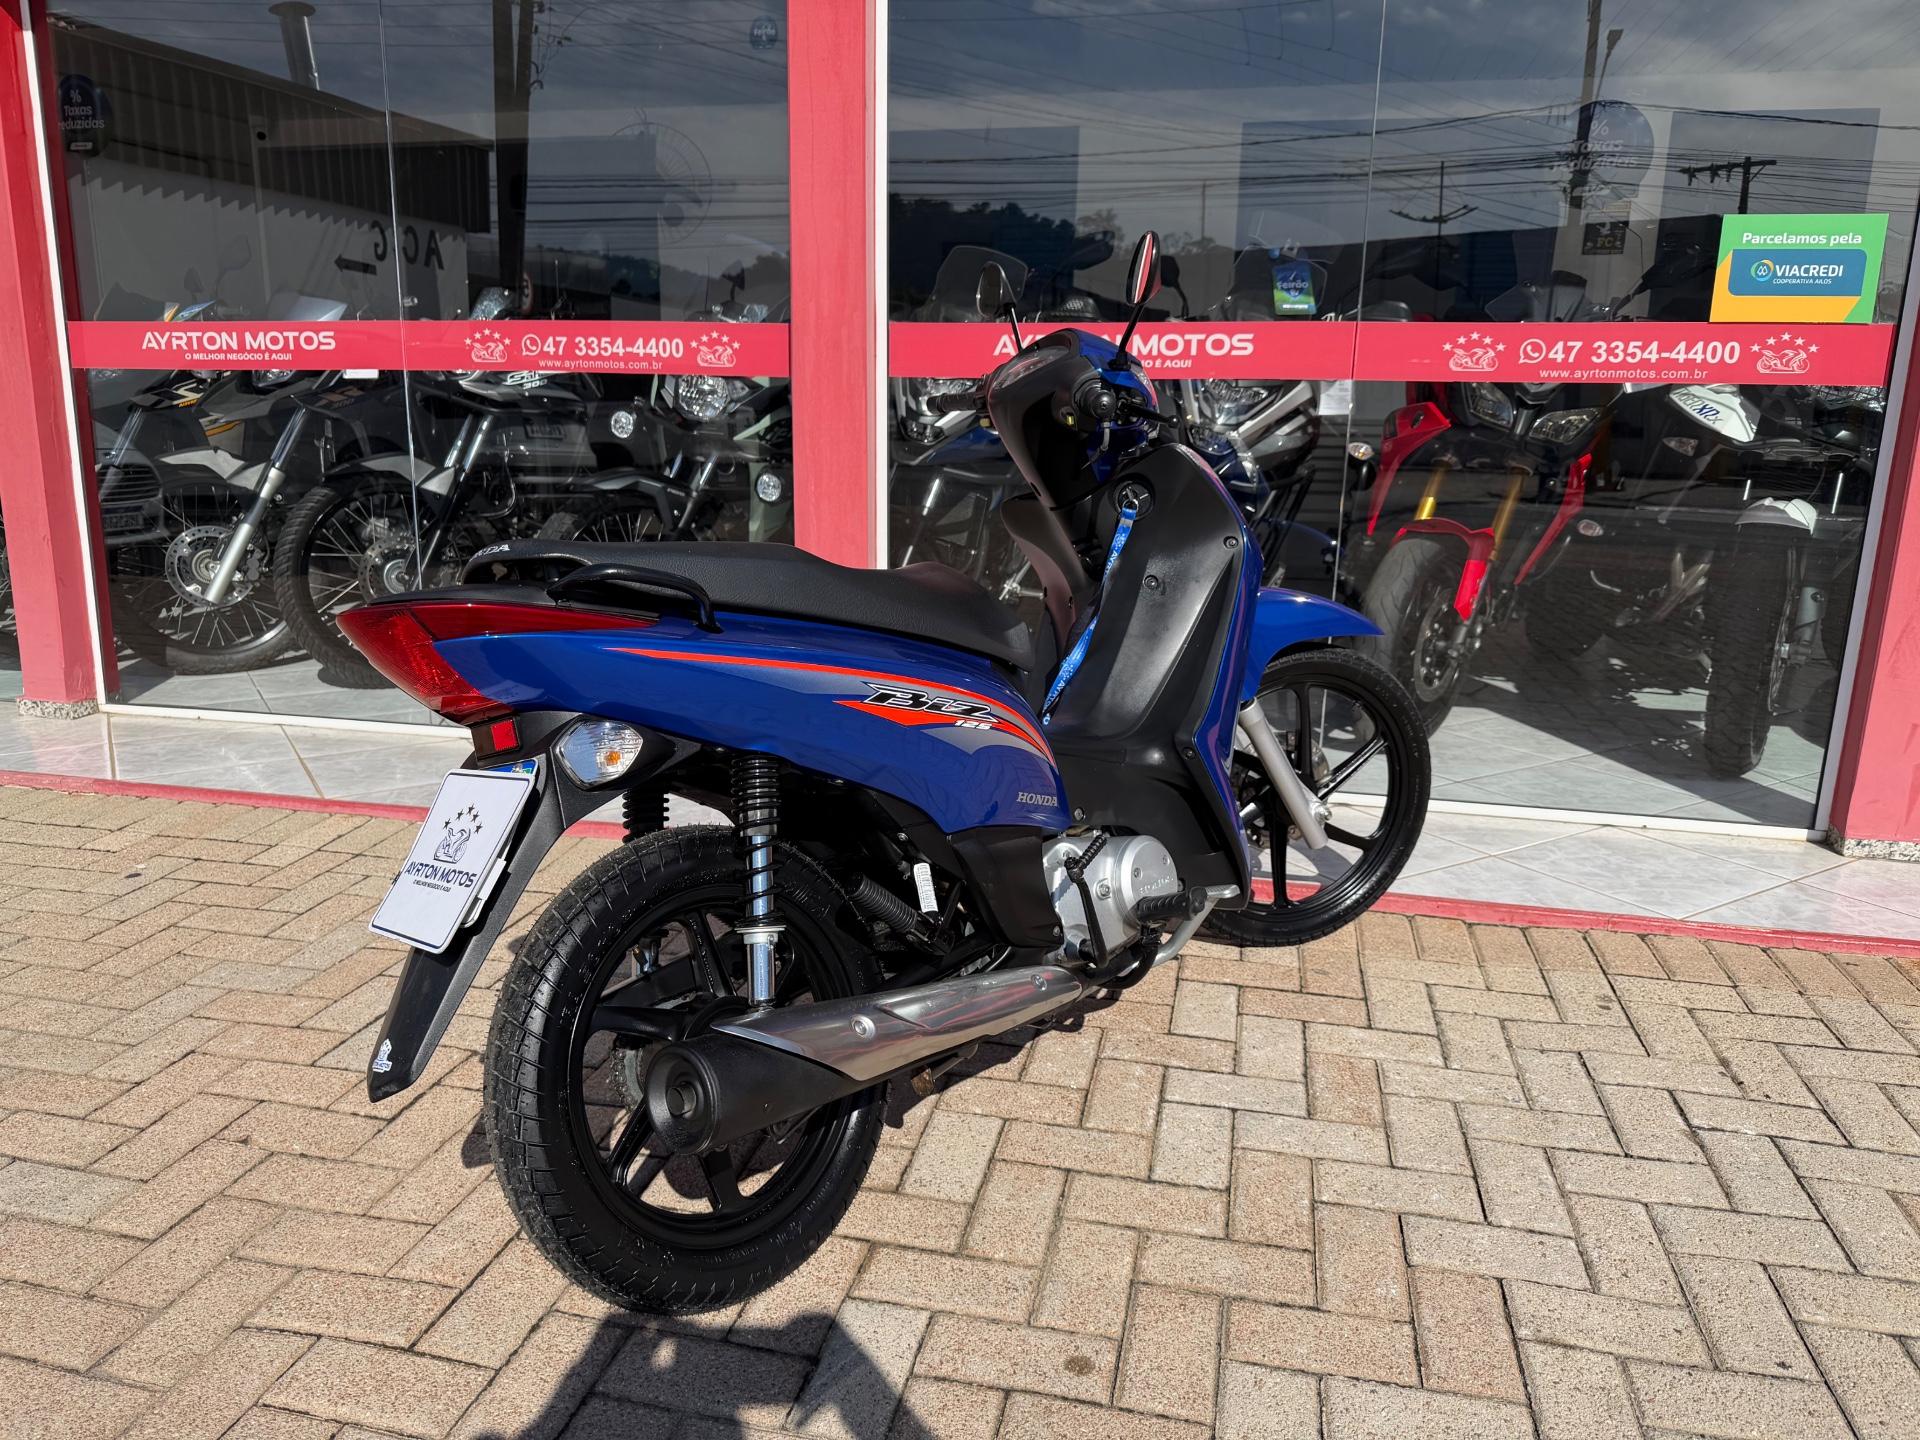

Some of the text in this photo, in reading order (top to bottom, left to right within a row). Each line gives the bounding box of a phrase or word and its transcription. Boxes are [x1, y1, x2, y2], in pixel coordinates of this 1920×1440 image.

[64, 105, 93, 117] Taxas
[1742, 232, 1862, 246] Parcelamos pela
[1775, 264, 1844, 277] VIACREDI
[141, 331, 336, 351] AYRTON MOTOS
[543, 336, 684, 358] 47 3354-4400
[1132, 333, 1255, 356] MOTOS
[193, 353, 225, 361] MELHOR
[227, 352, 263, 360] NEGÓCIO
[1548, 341, 1741, 364] 47 3354-4400
[538, 359, 662, 370] www.ayrtonmotos.com.br
[1163, 360, 1192, 368] AQUI
[1539, 369, 1708, 380] www.ayrtonmotos.com.br
[862, 681, 1000, 723] Biz
[954, 720, 993, 730] 125
[1016, 791, 1058, 807] HONDA
[404, 861, 477, 888] AYRTON MOTOS
